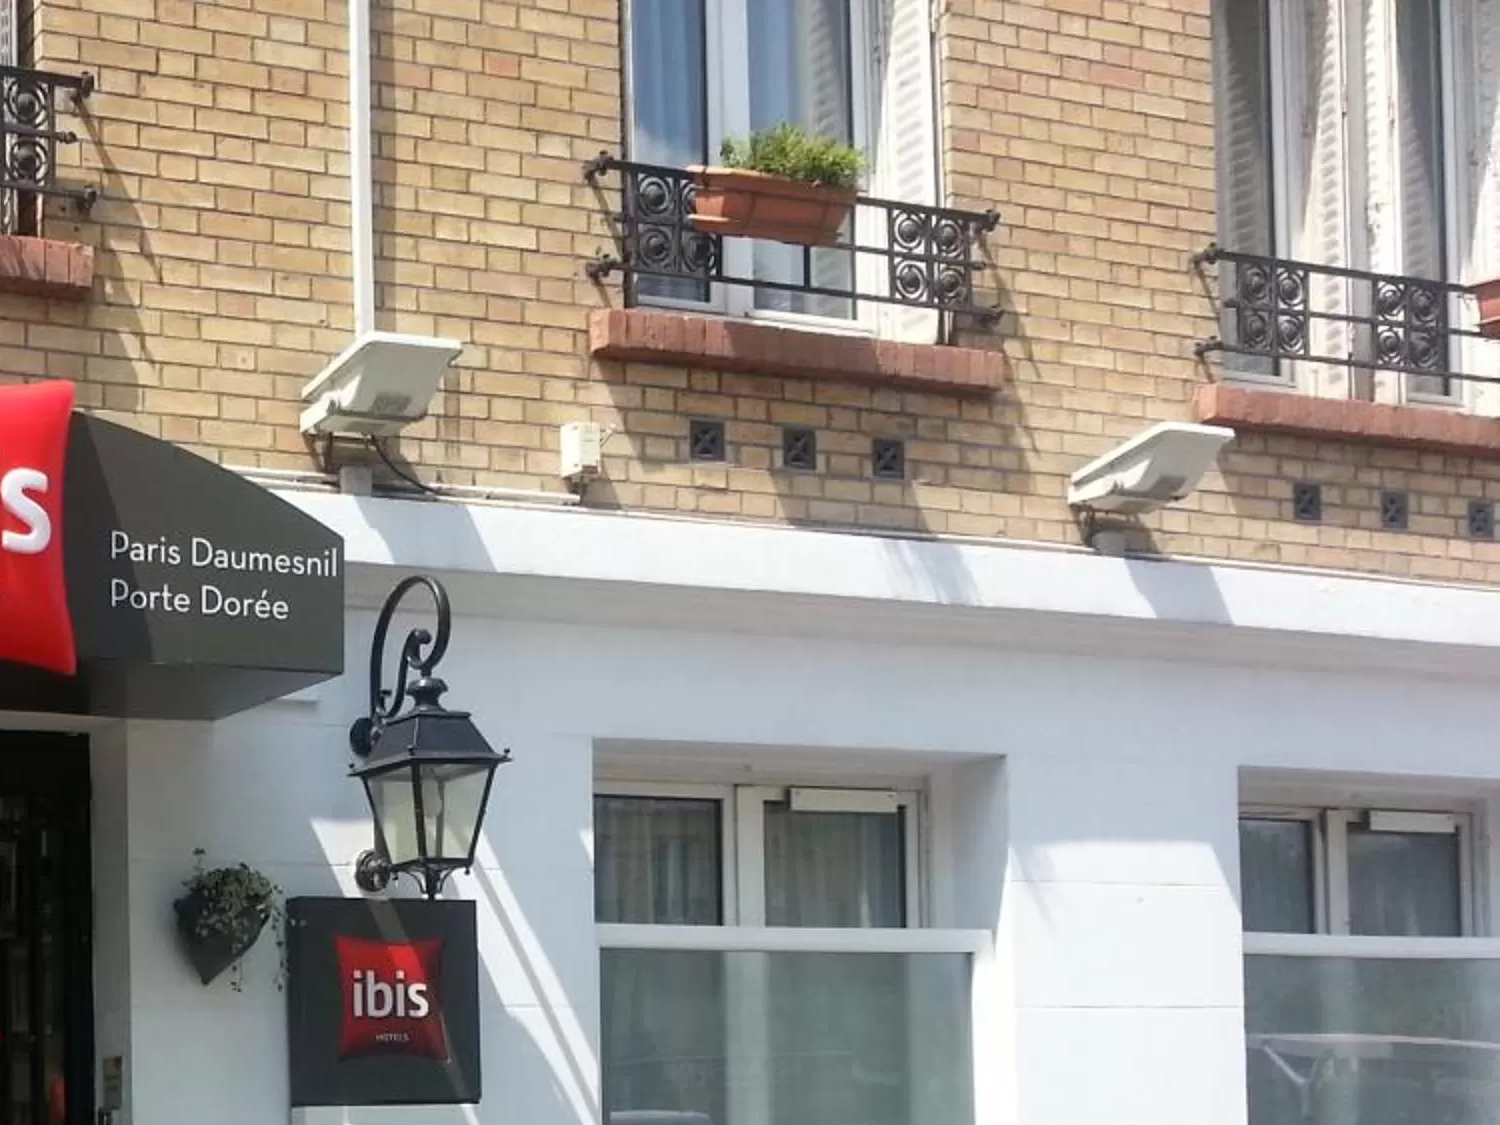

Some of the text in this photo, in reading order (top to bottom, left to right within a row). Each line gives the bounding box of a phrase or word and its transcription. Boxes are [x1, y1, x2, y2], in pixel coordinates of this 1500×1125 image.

[111, 531, 339, 578] Paris Daumesnil
[110, 579, 290, 621] Porte Dorée
[353, 969, 431, 1018] ibis
